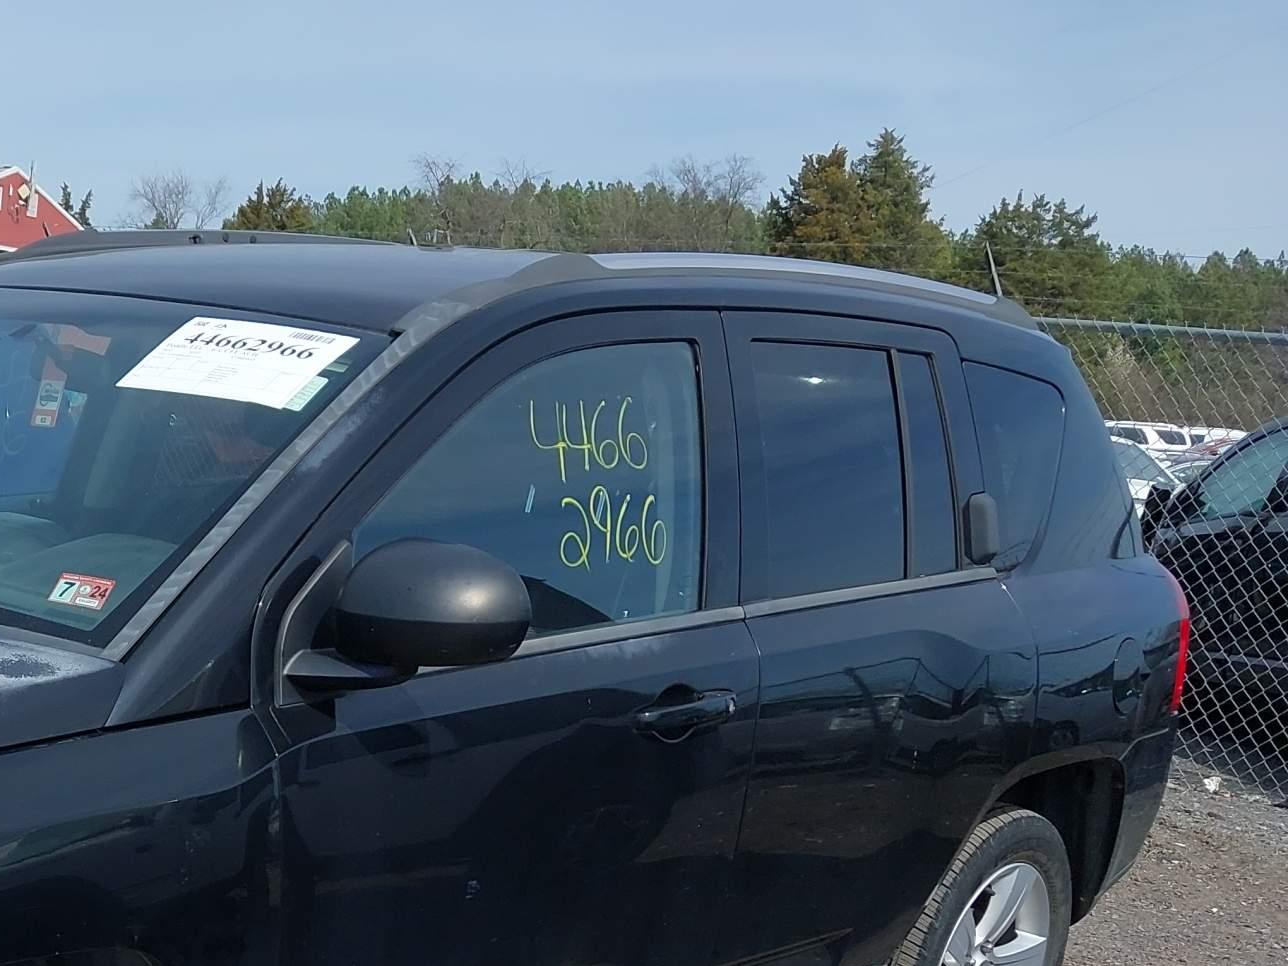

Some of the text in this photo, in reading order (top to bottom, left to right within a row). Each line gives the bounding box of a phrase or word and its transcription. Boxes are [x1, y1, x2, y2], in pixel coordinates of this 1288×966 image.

[184, 332, 321, 360] 44662966
[530, 396, 648, 484] 4466
[561, 486, 667, 573] 2966
[58, 581, 109, 600] 7 24
